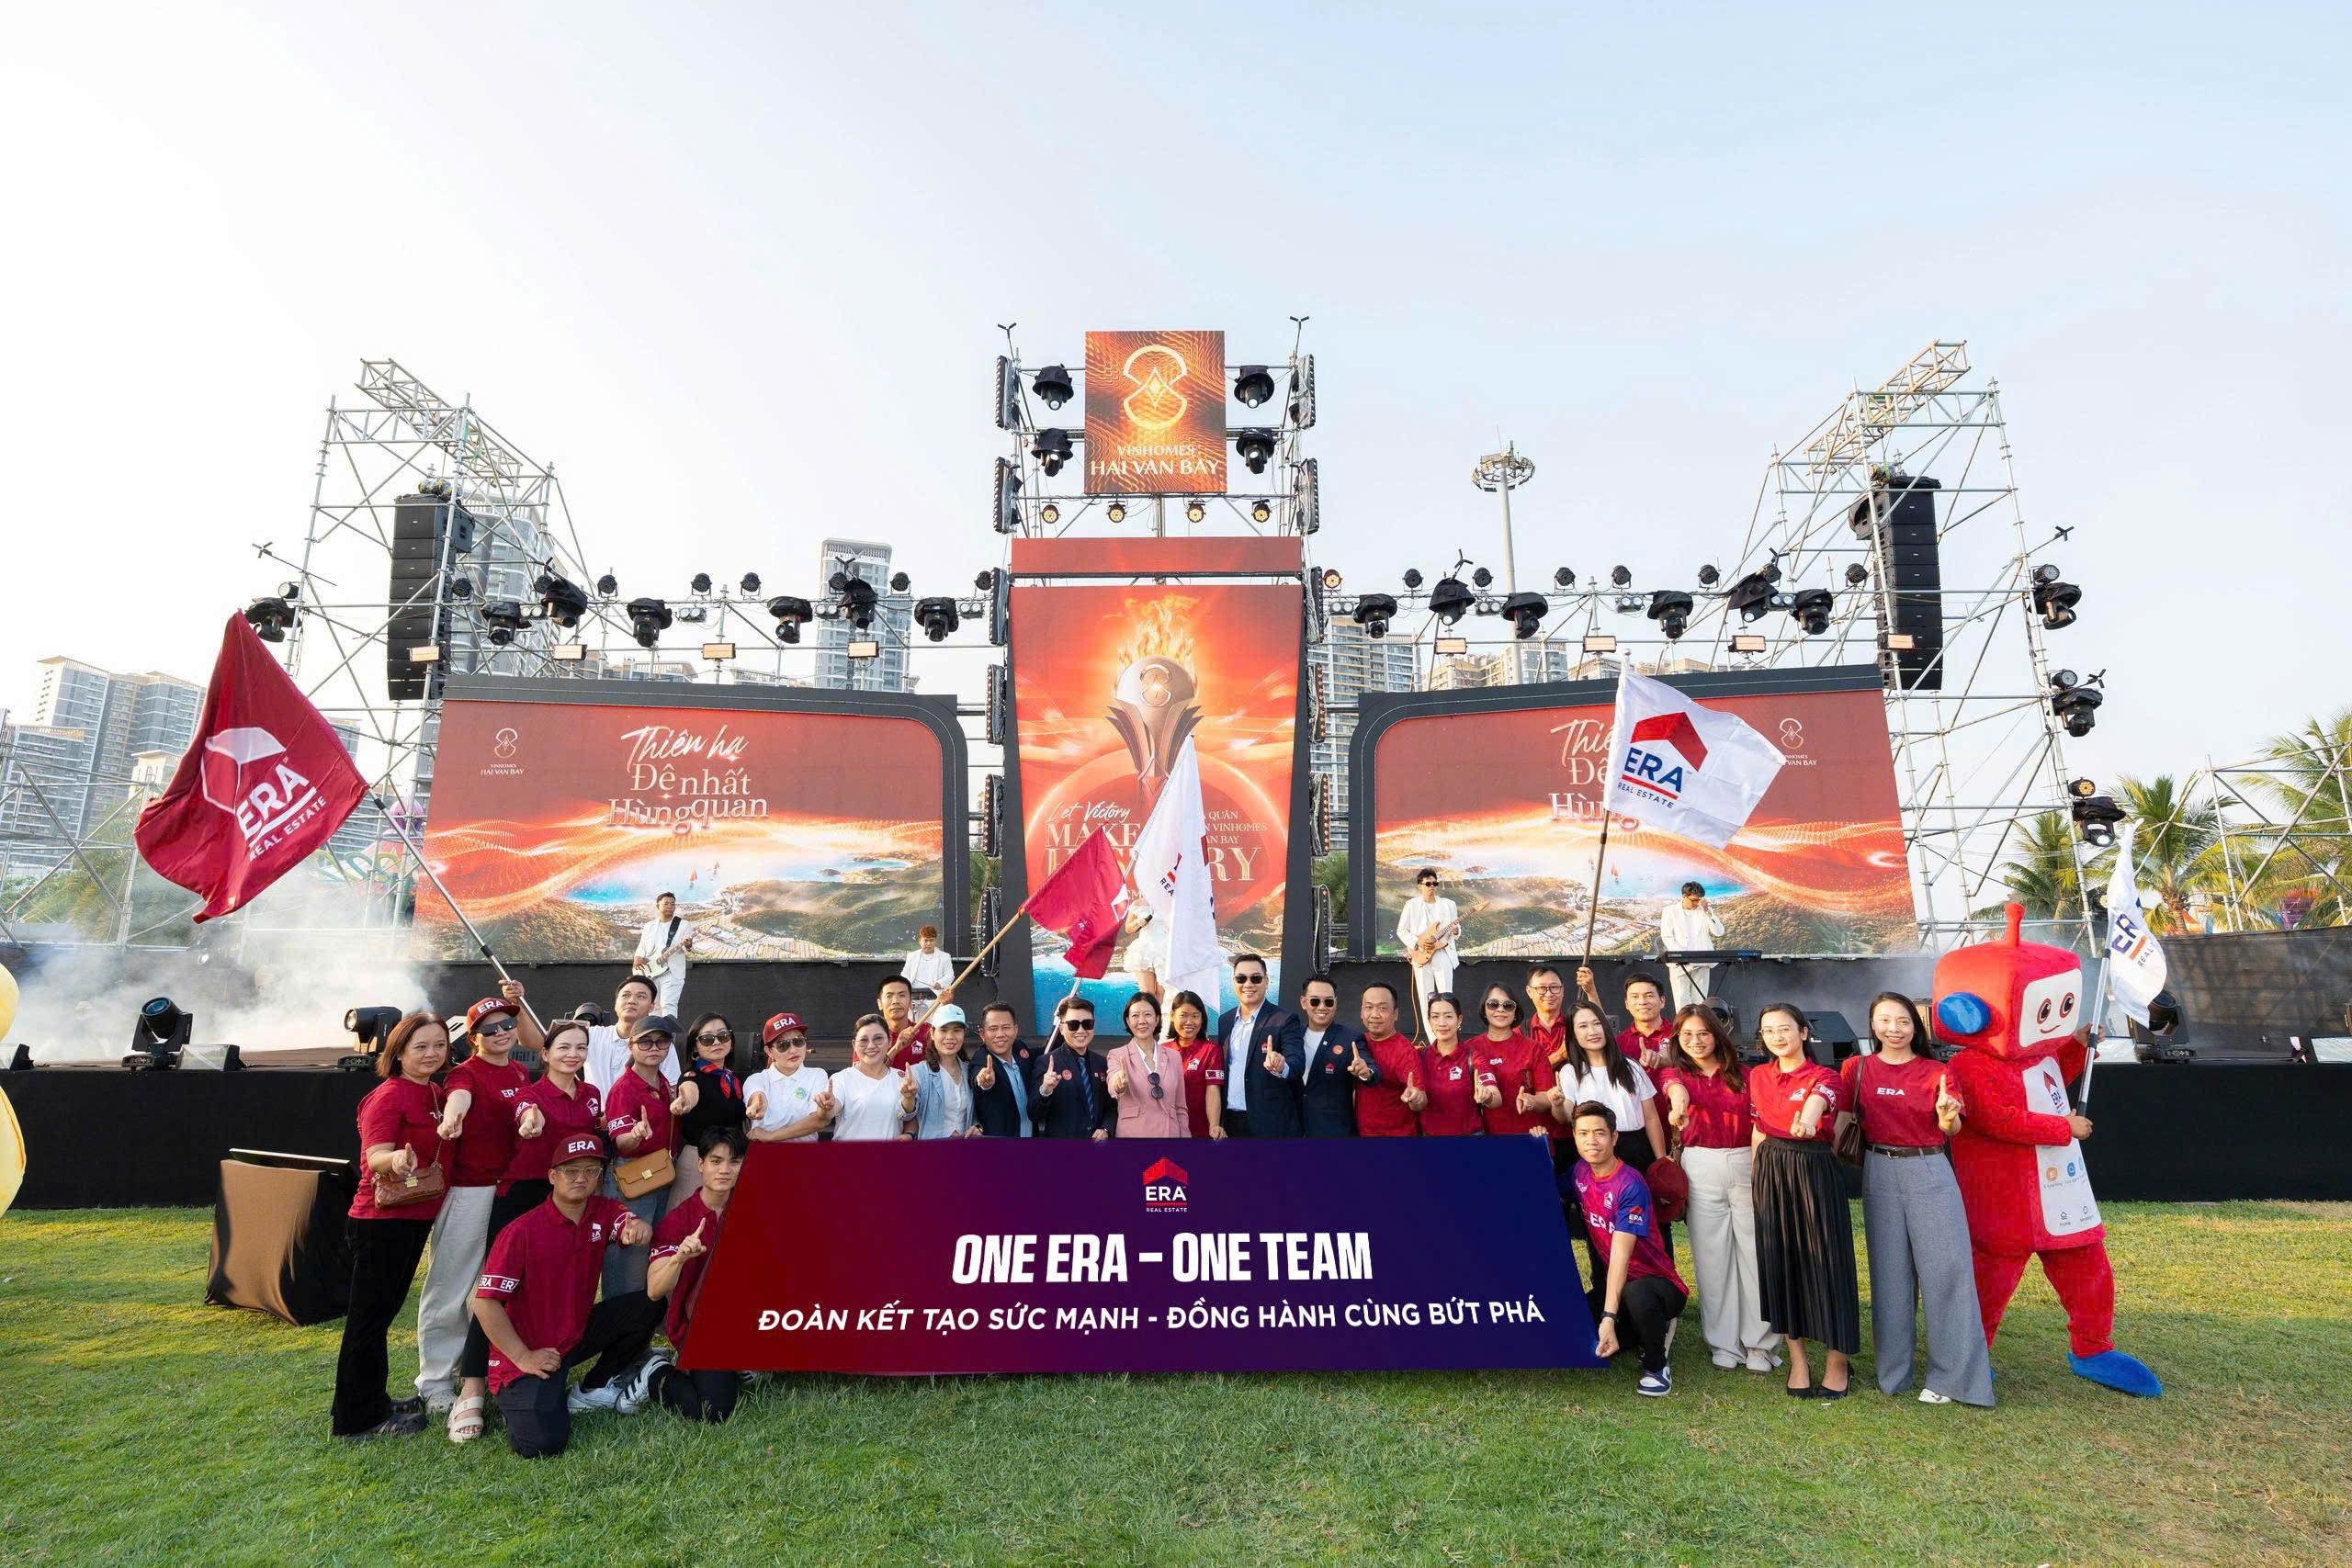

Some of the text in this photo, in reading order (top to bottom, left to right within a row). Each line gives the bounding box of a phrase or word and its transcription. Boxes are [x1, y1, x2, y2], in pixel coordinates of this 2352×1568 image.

[1117, 445, 1194, 456] VINHOMES
[1090, 459, 1220, 475] HAI VAN BAY
[620, 725, 708, 773] Thiên
[1623, 747, 1683, 794] ERA
[236, 763, 310, 841] ERA
[1617, 783, 1675, 809] REAL ESTATE
[249, 795, 327, 862] REAL ESTATE
[2111, 913, 2140, 954] ER
[477, 999, 504, 1015] ERA
[773, 1017, 797, 1031] ERA
[1876, 1087, 1905, 1096] ERA
[568, 1140, 596, 1154] ERA
[1146, 1186, 1187, 1201] ERA
[1628, 1213, 1644, 1223] ERA
[952, 1234, 1037, 1284] ONE
[1046, 1234, 1128, 1283] ERA
[1172, 1232, 1251, 1282] ONE
[1259, 1232, 1374, 1280] TEAM
[758, 1303, 849, 1331] ĐOÀN
[856, 1299, 914, 1331] KẾT
[922, 1308, 979, 1336] TẠO
[988, 1302, 1047, 1330] SỨC
[1056, 1307, 1138, 1336] MẠNH
[1166, 1296, 1250, 1329] ĐỒNG
[1259, 1299, 1336, 1328] HÀNH
[1344, 1298, 1420, 1327] CÙNG
[1428, 1296, 1480, 1325] BỨT
[1488, 1293, 1545, 1324] PHÁ
